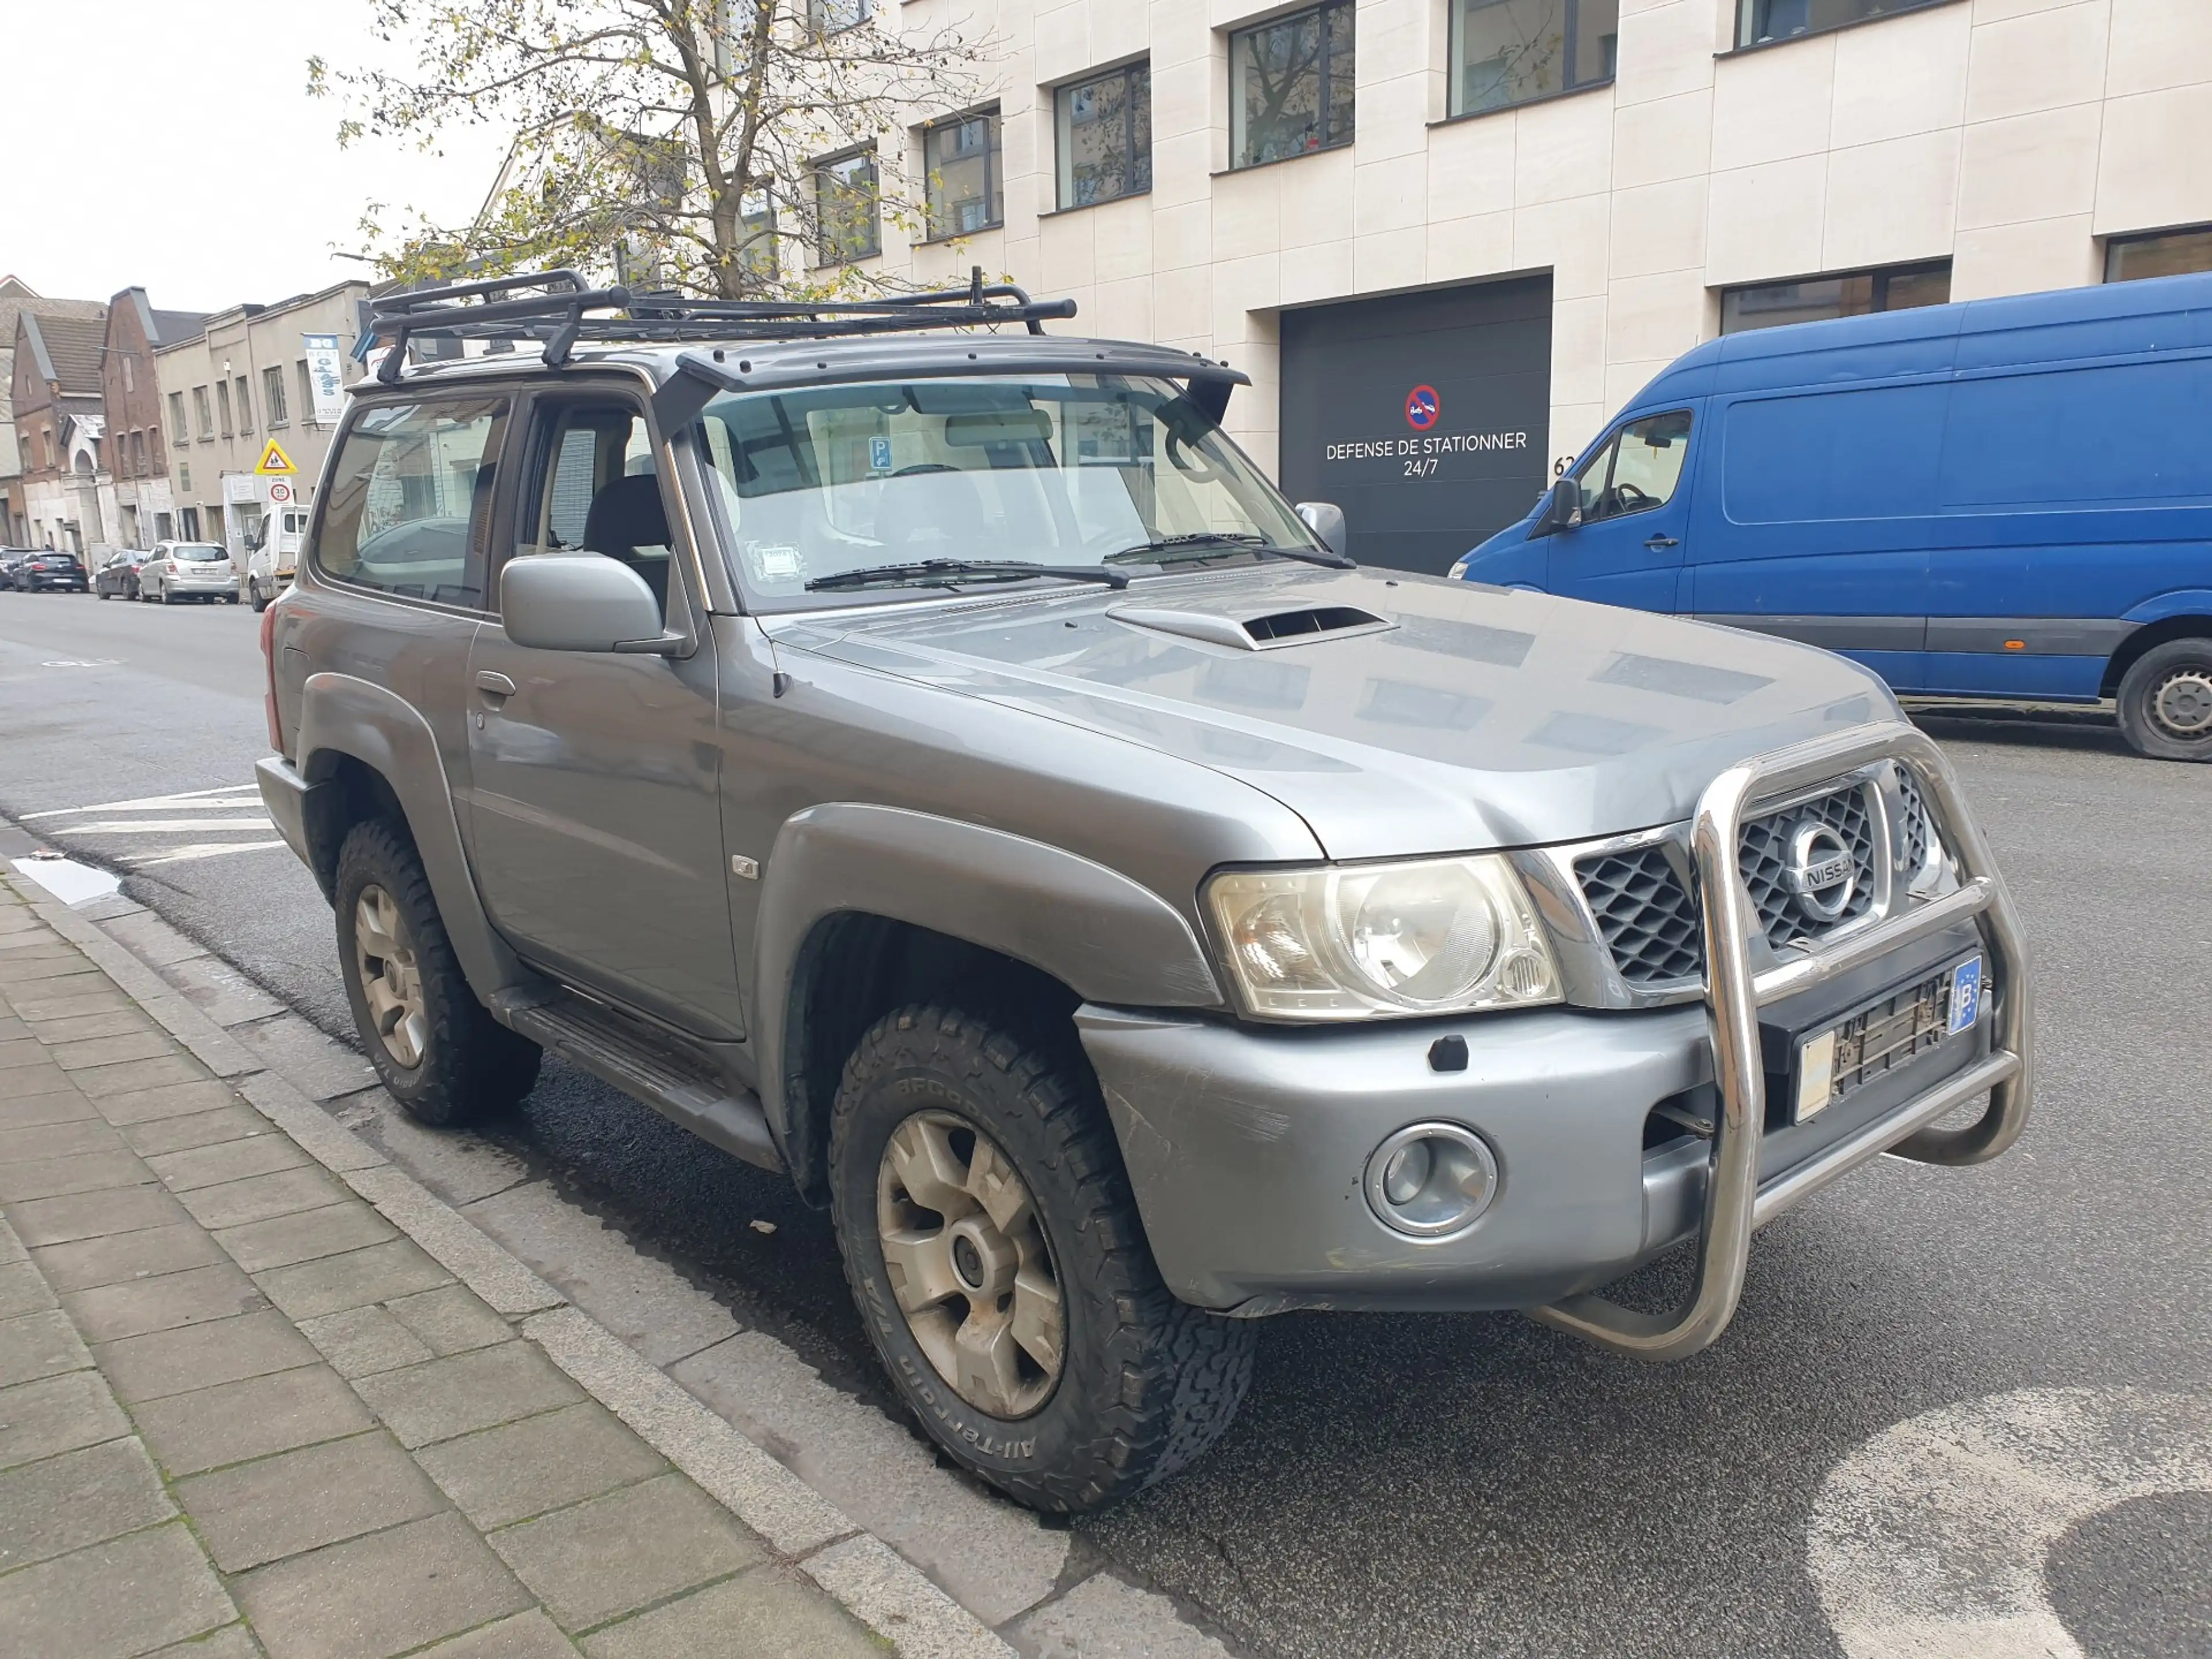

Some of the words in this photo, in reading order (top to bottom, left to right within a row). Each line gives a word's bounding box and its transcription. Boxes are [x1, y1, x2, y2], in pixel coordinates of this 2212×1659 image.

[876, 441, 885, 456] P
[1327, 441, 1393, 460] DEFENSE
[1398, 439, 1419, 456] DE
[1423, 432, 1527, 454] STATIONNER
[1404, 459, 1438, 477] 24/7
[1807, 859, 1853, 886] NISSAN
[1962, 986, 1972, 1008] B
[864, 1275, 893, 1338] T/A
[899, 1355, 1037, 1459] All-Terrain
